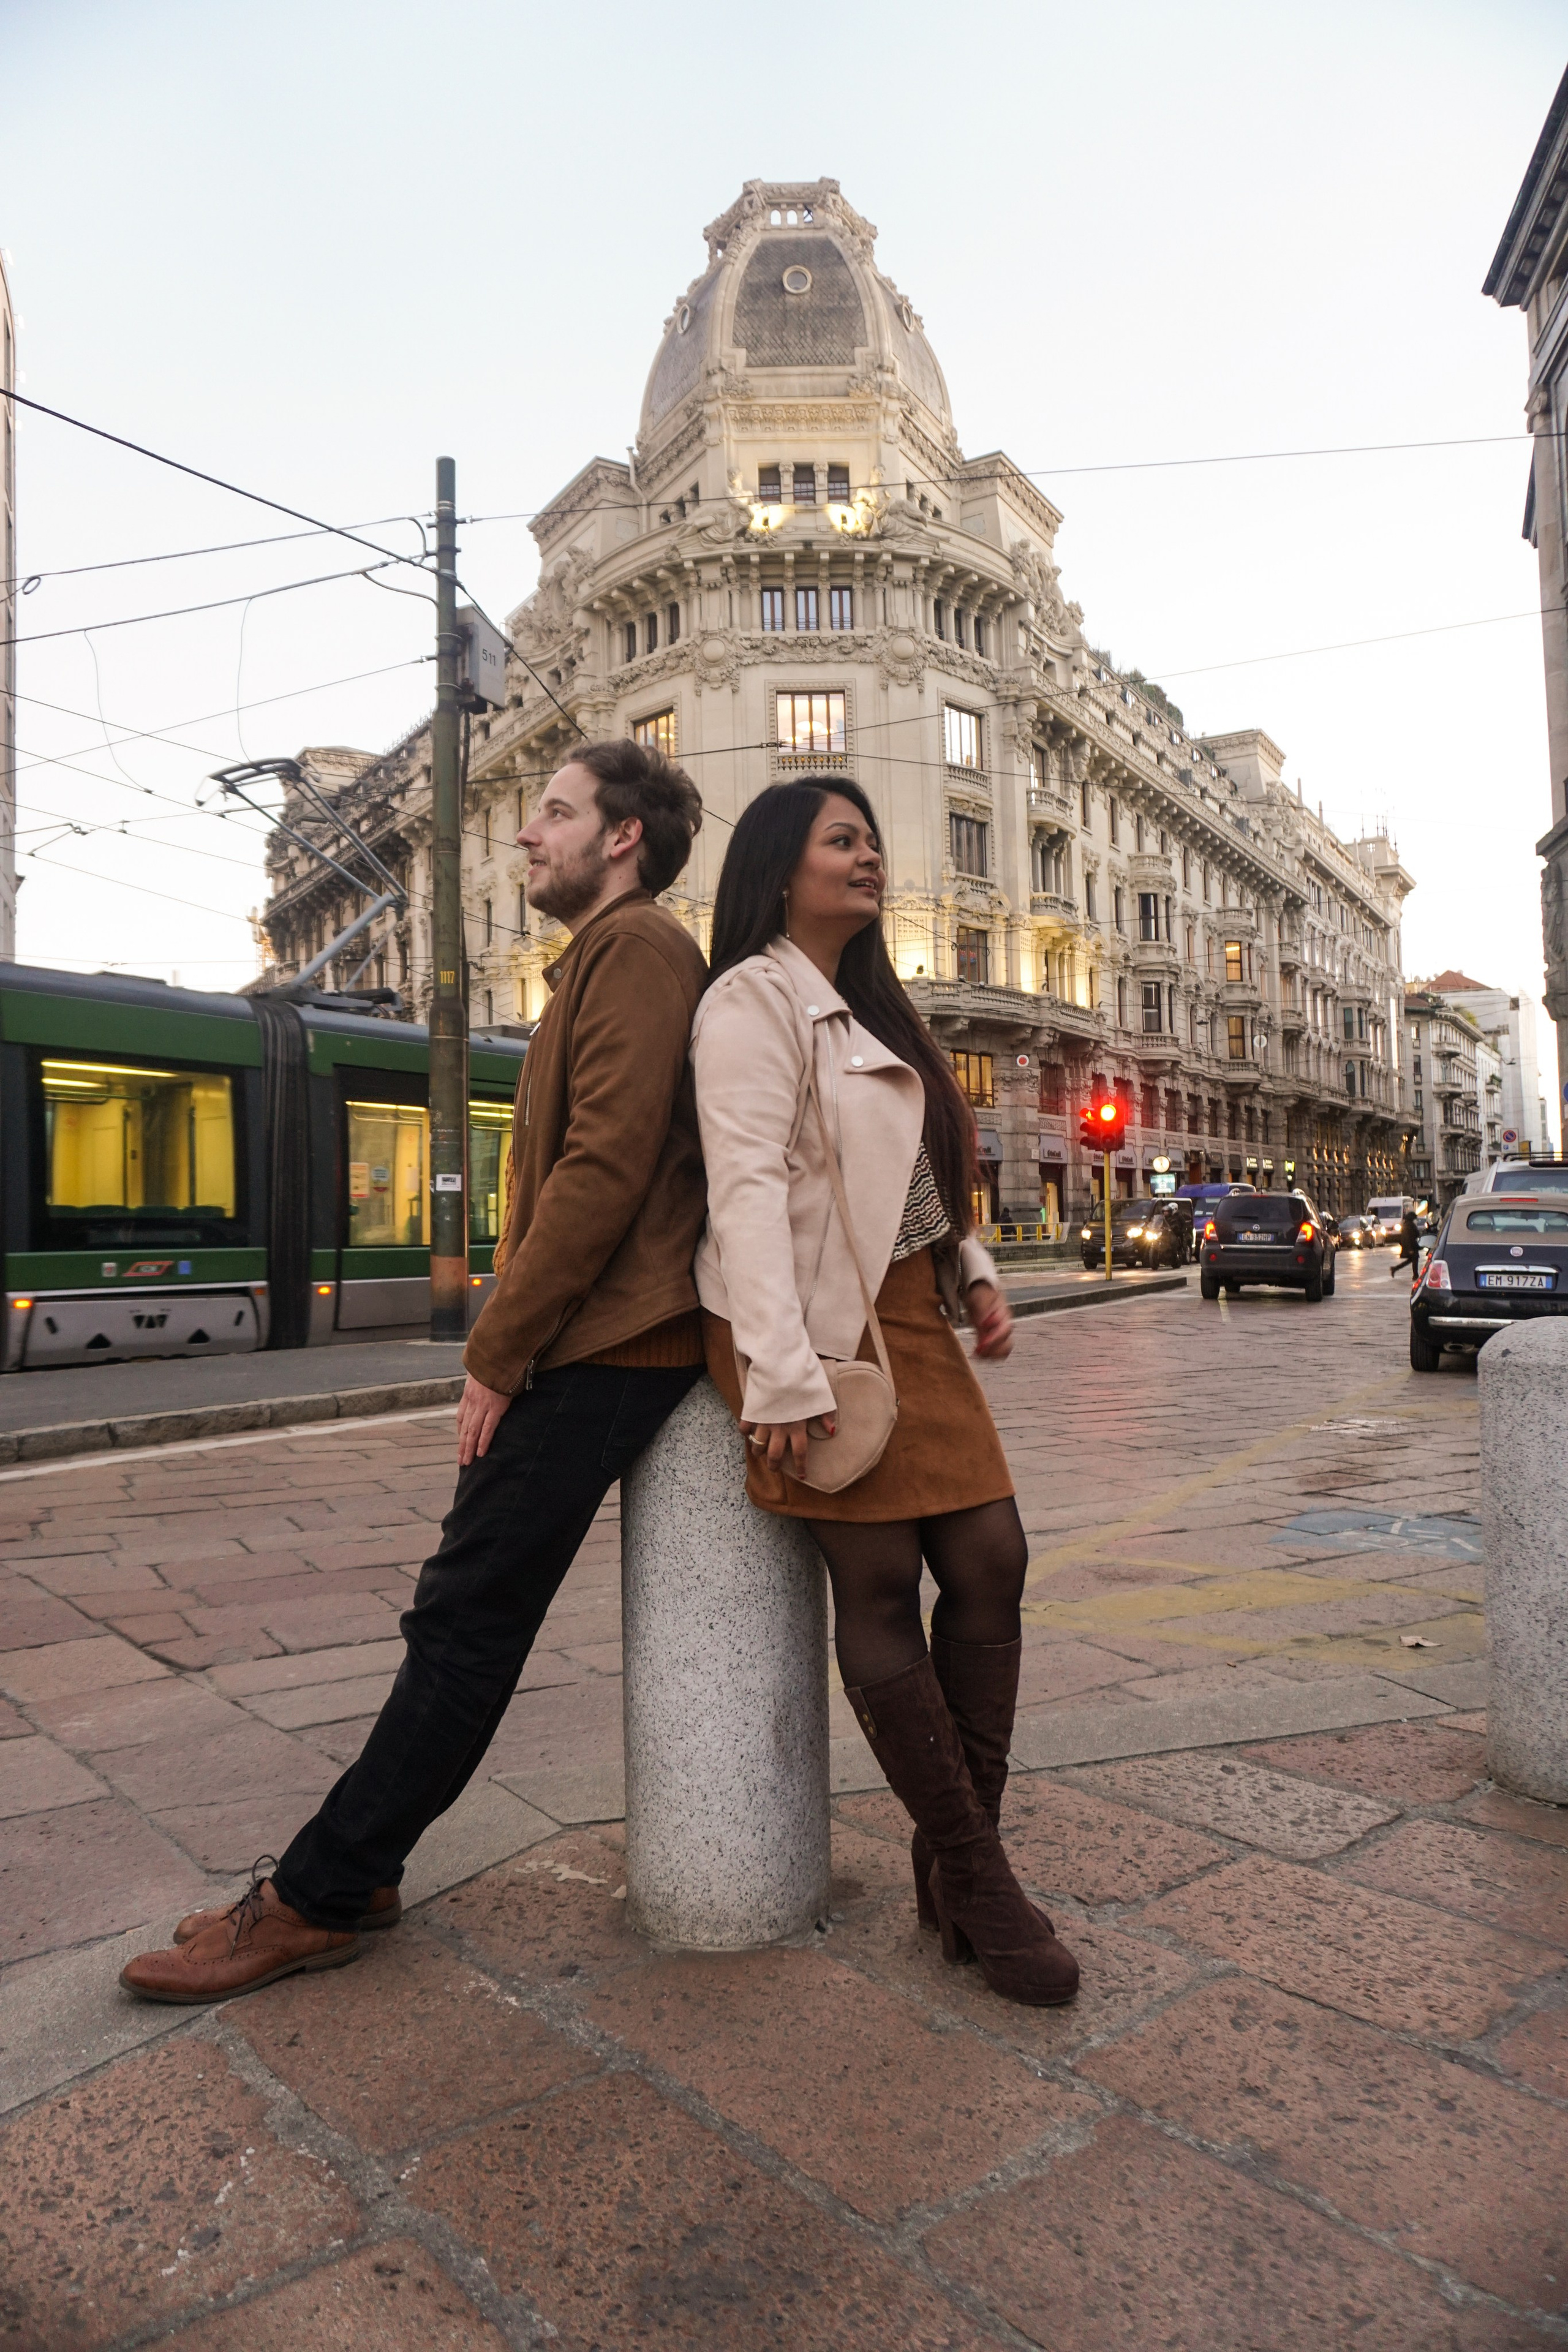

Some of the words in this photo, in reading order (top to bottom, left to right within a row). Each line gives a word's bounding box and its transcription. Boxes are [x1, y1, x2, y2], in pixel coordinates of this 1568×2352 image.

[482, 649, 496, 666] 511
[440, 971, 454, 983] 1117
[1488, 1275, 1502, 1286] EM
[1507, 1275, 1544, 1287] 917ZA
